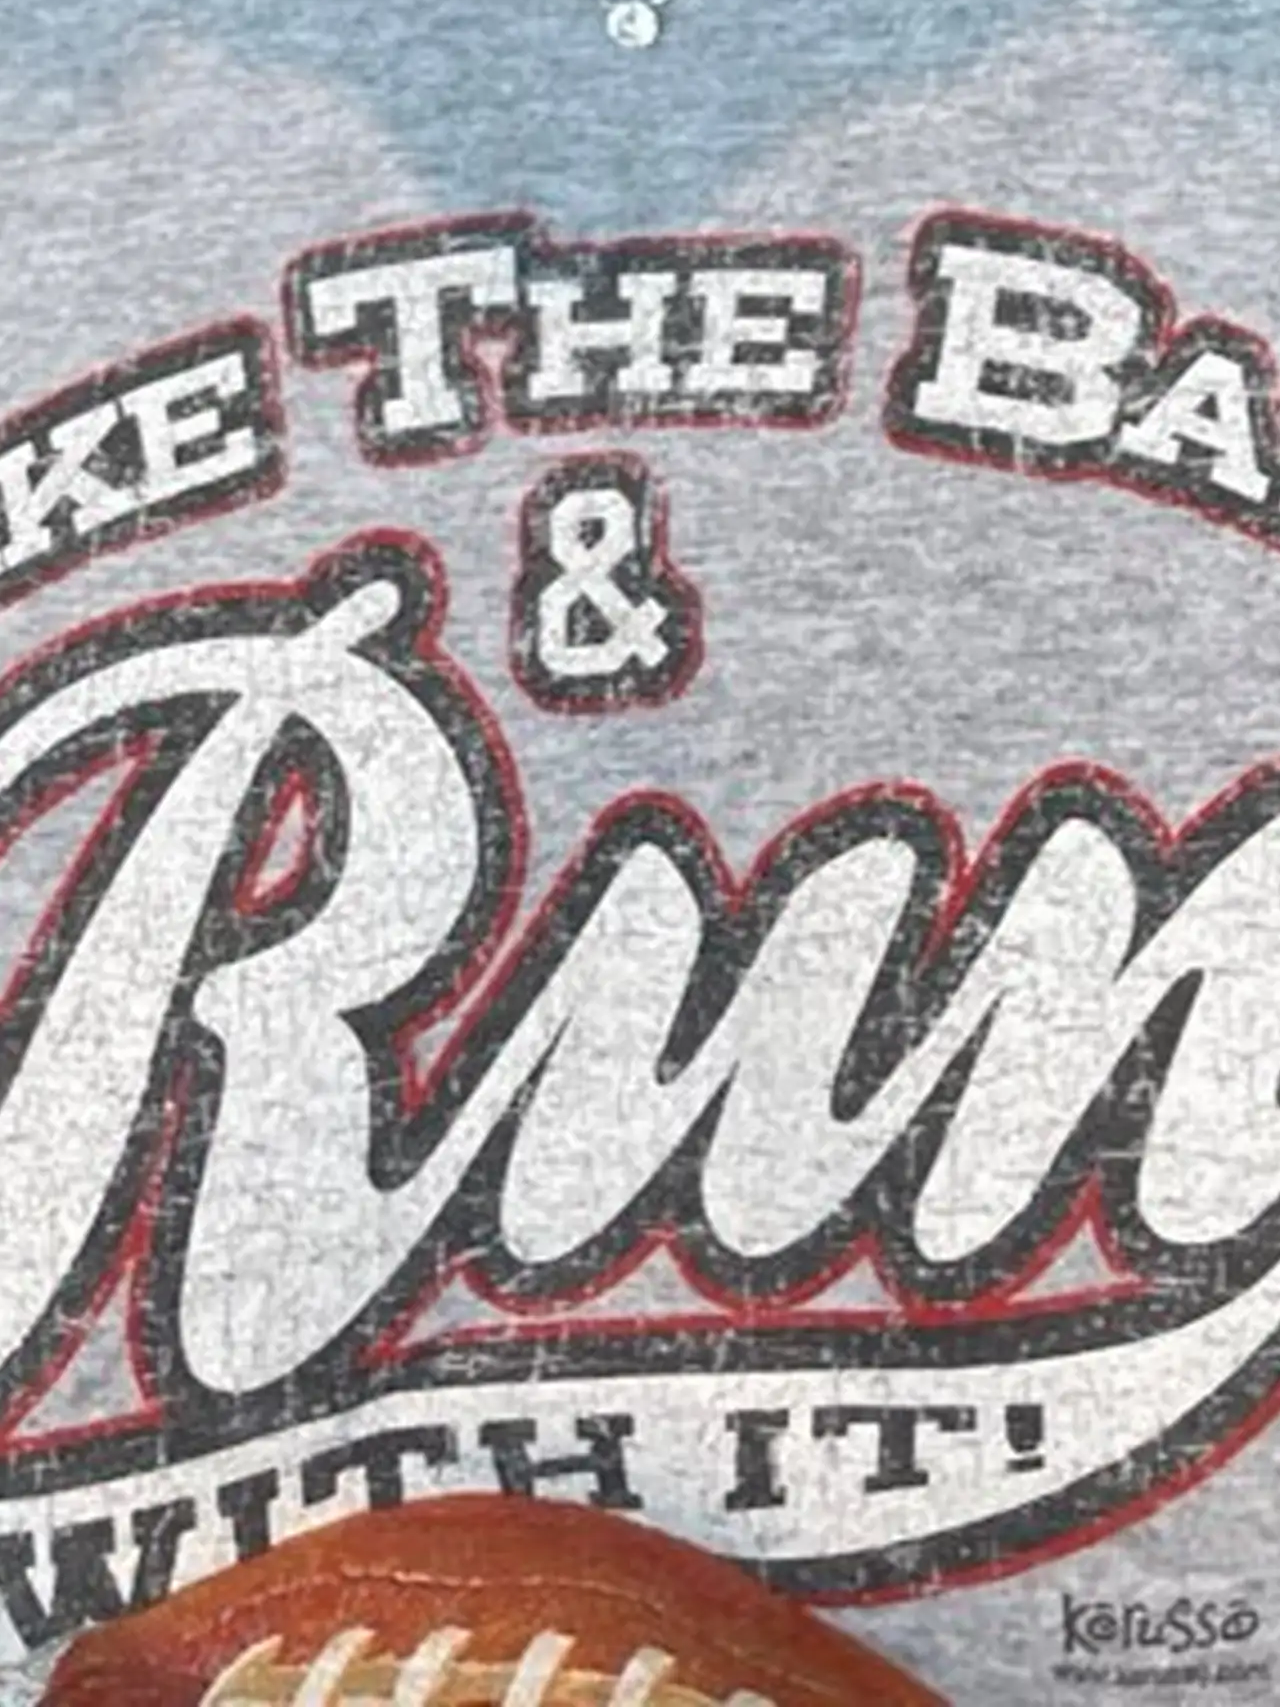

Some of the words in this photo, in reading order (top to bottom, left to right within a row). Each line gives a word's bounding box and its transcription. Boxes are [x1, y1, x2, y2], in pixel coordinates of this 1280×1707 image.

[295, 229, 845, 447] THE
[520, 472, 685, 692] &
[723, 1402, 1046, 1512] IT!
